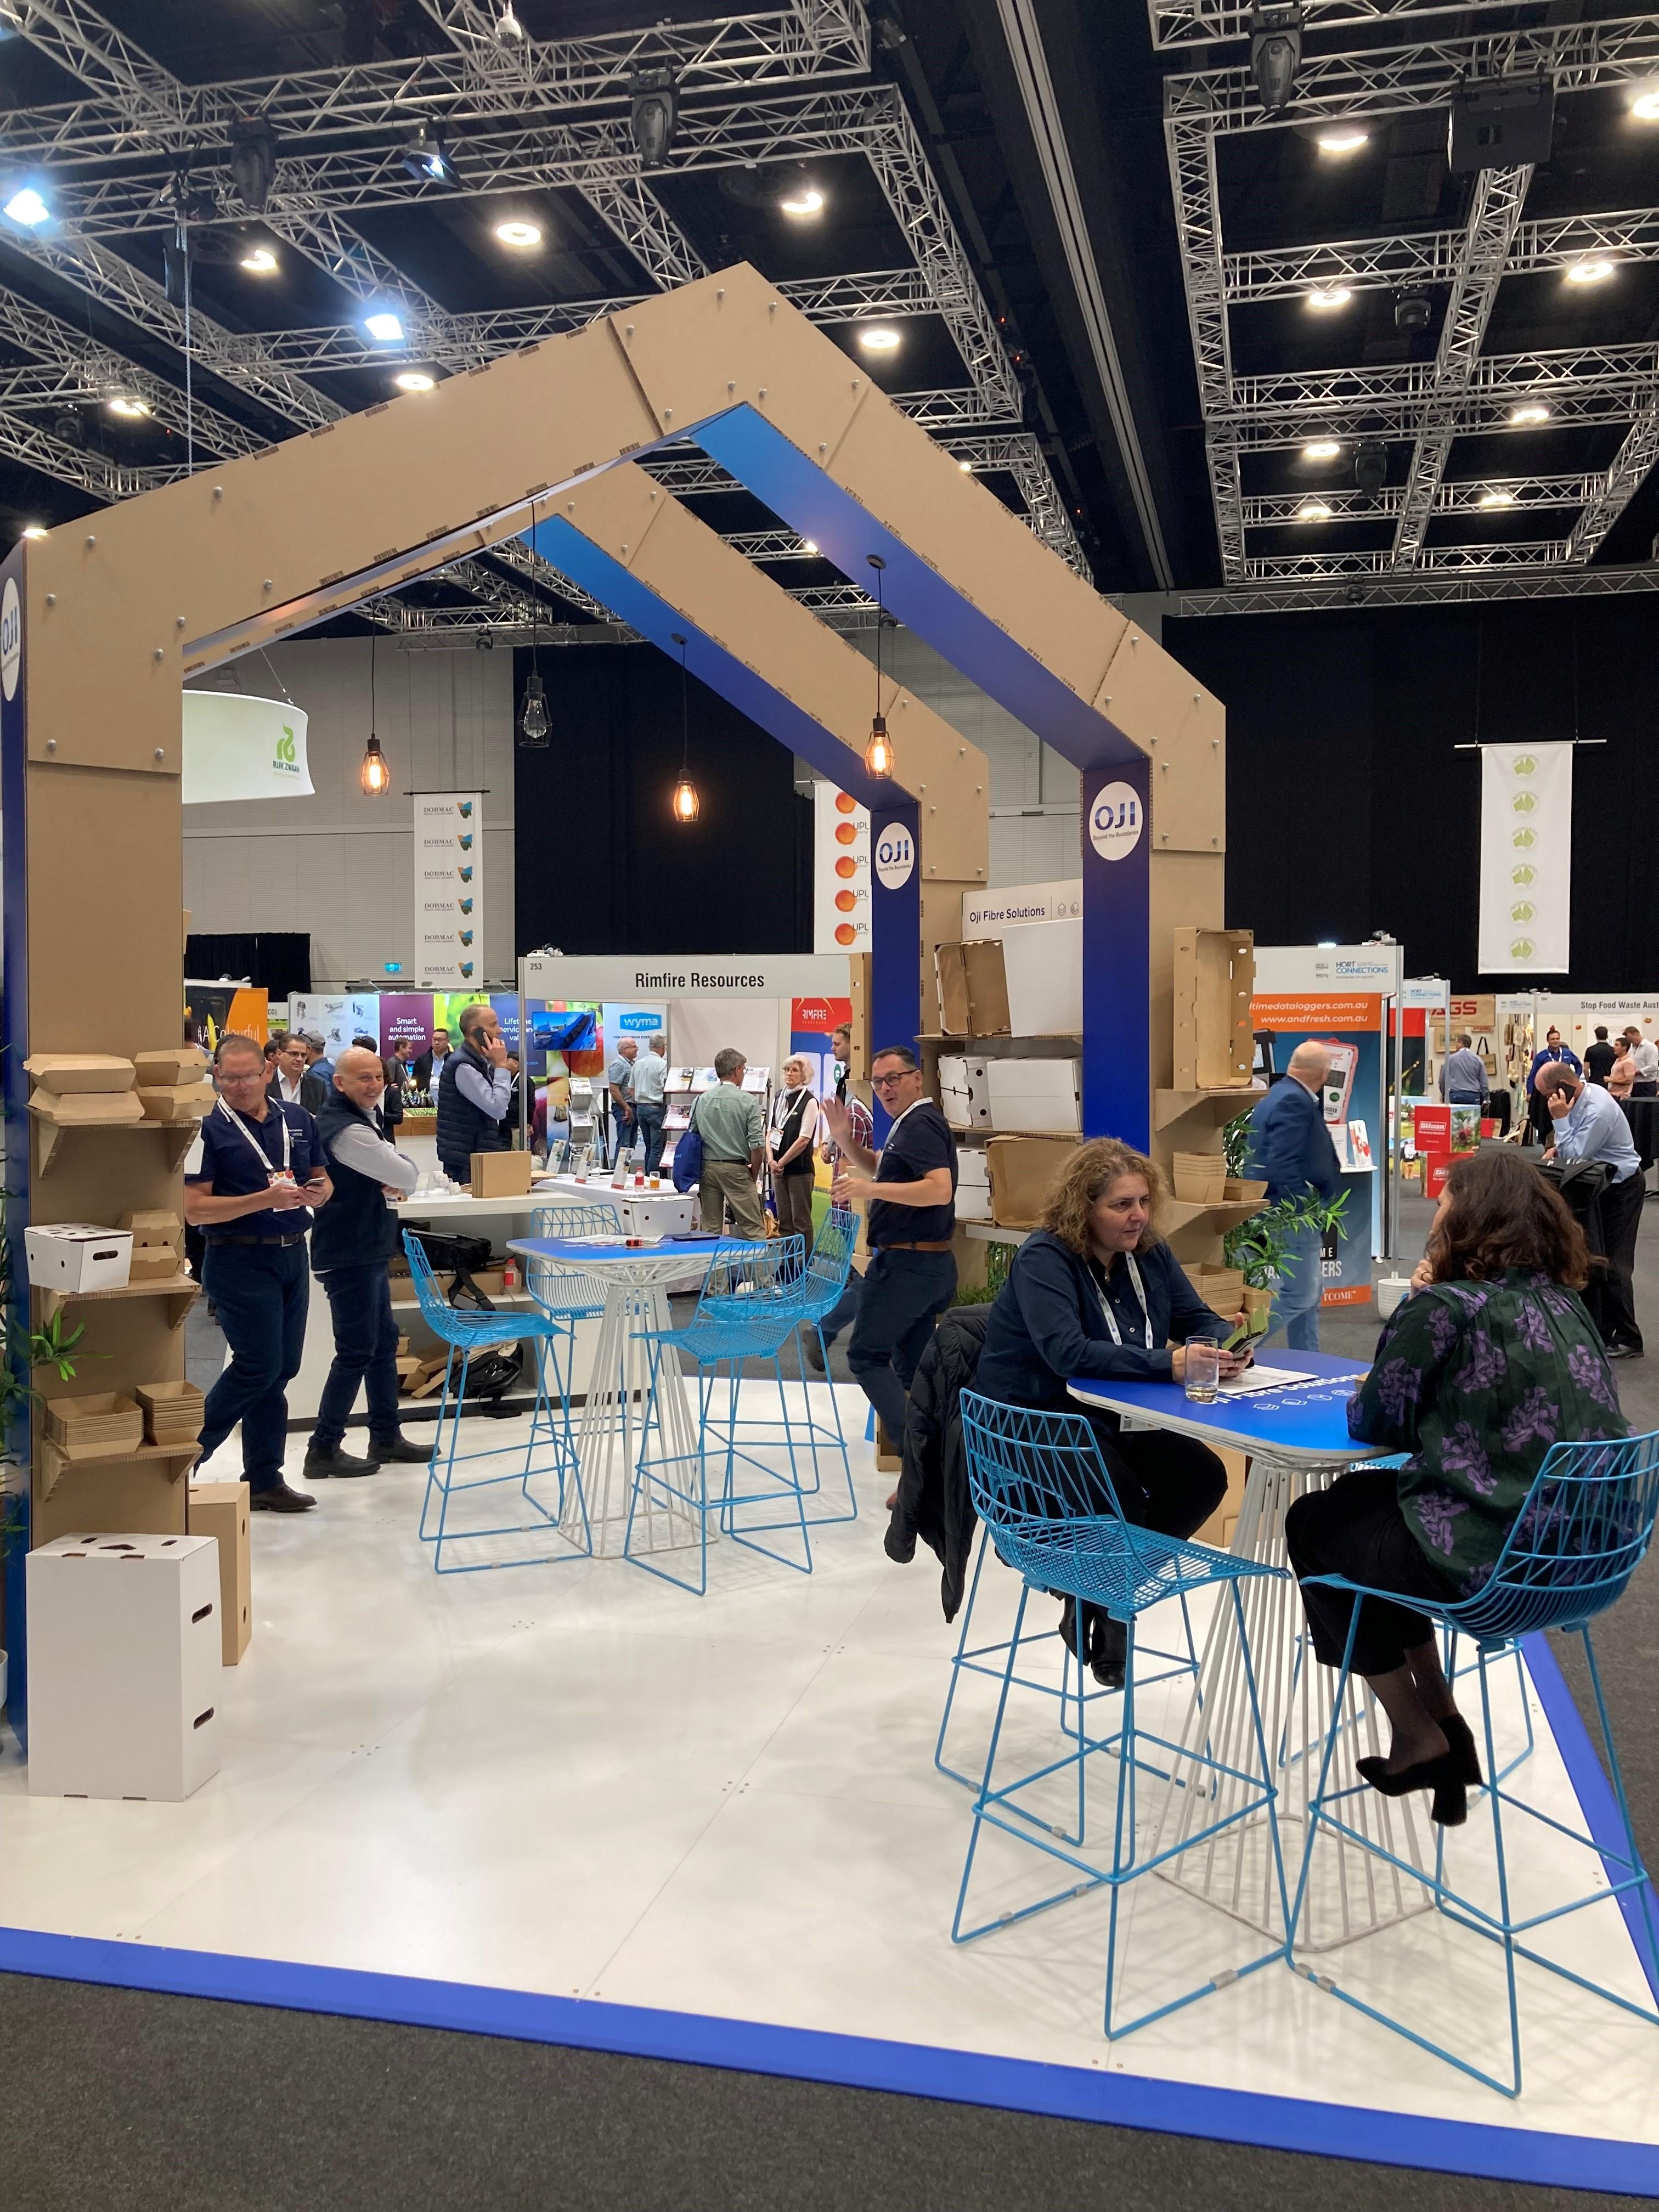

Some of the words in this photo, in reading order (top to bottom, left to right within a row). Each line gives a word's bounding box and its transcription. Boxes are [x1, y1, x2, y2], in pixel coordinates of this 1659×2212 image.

[2, 606, 17, 655] OJI
[273, 761, 284, 770] RIJK
[1094, 802, 1135, 830] OJI
[879, 840, 909, 864] OJI
[853, 889, 869, 898] UPL
[970, 911, 981, 924] Oji
[983, 911, 1004, 921] Fibre
[1007, 906, 1045, 919] Solutions
[853, 923, 868, 931] UPL
[636, 973, 686, 988] Rimfire
[691, 973, 764, 987] Resources
[1249, 1001, 1368, 1011] ltimedataloggers.com.au
[1581, 1001, 1596, 1010] Stop
[802, 1009, 827, 1020] RIMFIRE
[1261, 1015, 1368, 1023] www.andfresh.com.au
[624, 1018, 658, 1029] wyma
[403, 1025, 425, 1034] simple
[1319, 1247, 1333, 1257] ME
[1322, 1261, 1342, 1277] ERS
